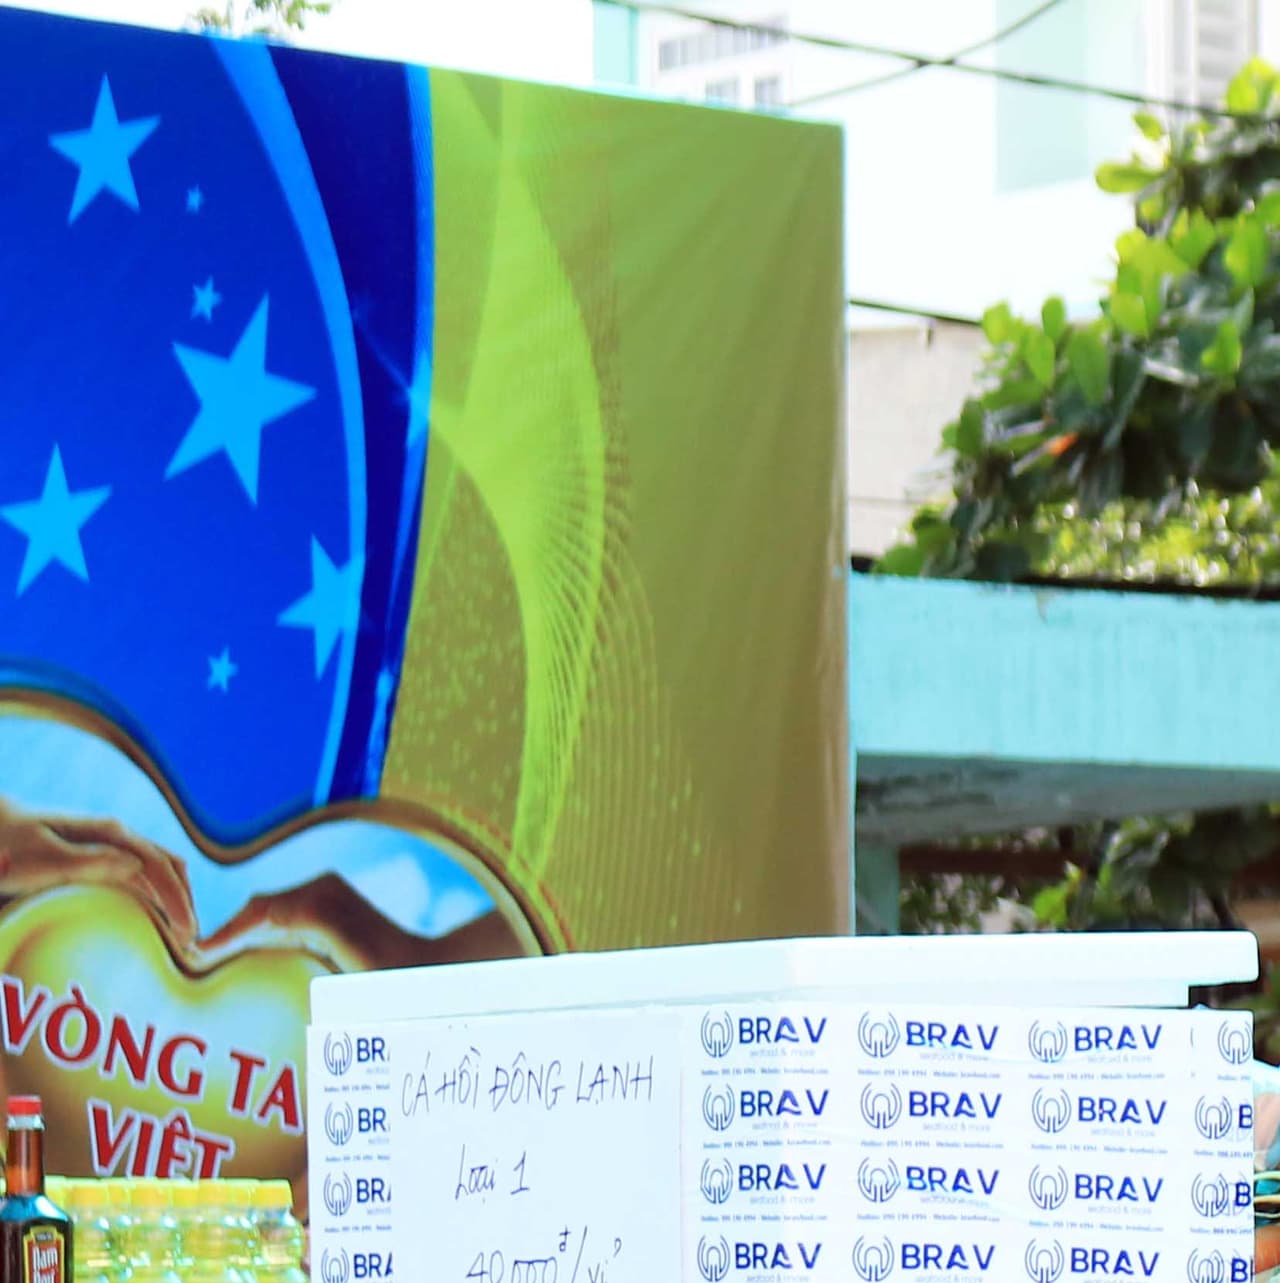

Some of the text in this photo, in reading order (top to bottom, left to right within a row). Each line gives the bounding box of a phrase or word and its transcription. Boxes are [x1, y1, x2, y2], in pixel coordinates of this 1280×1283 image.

[3, 983, 207, 1097] VÒNG
[740, 1018, 825, 1043] BRAV
[907, 1023, 997, 1049] BRAV
[1075, 1026, 1160, 1051] BRAV
[402, 1046, 653, 1117] CÁ HỒI ĐÔNG LẠNH
[741, 1091, 828, 1116] BRAV
[910, 1092, 1000, 1118] BRAV
[1079, 1098, 1165, 1124] BRAV
[510, 1150, 530, 1195] 1
[739, 1165, 824, 1190] BRAV
[907, 1167, 998, 1195] BRAV
[1076, 1175, 1162, 1202] BRAV
[736, 1243, 820, 1269] BRAV
[902, 1245, 994, 1270] BRAV
[1072, 1249, 1158, 1276] BRAV
